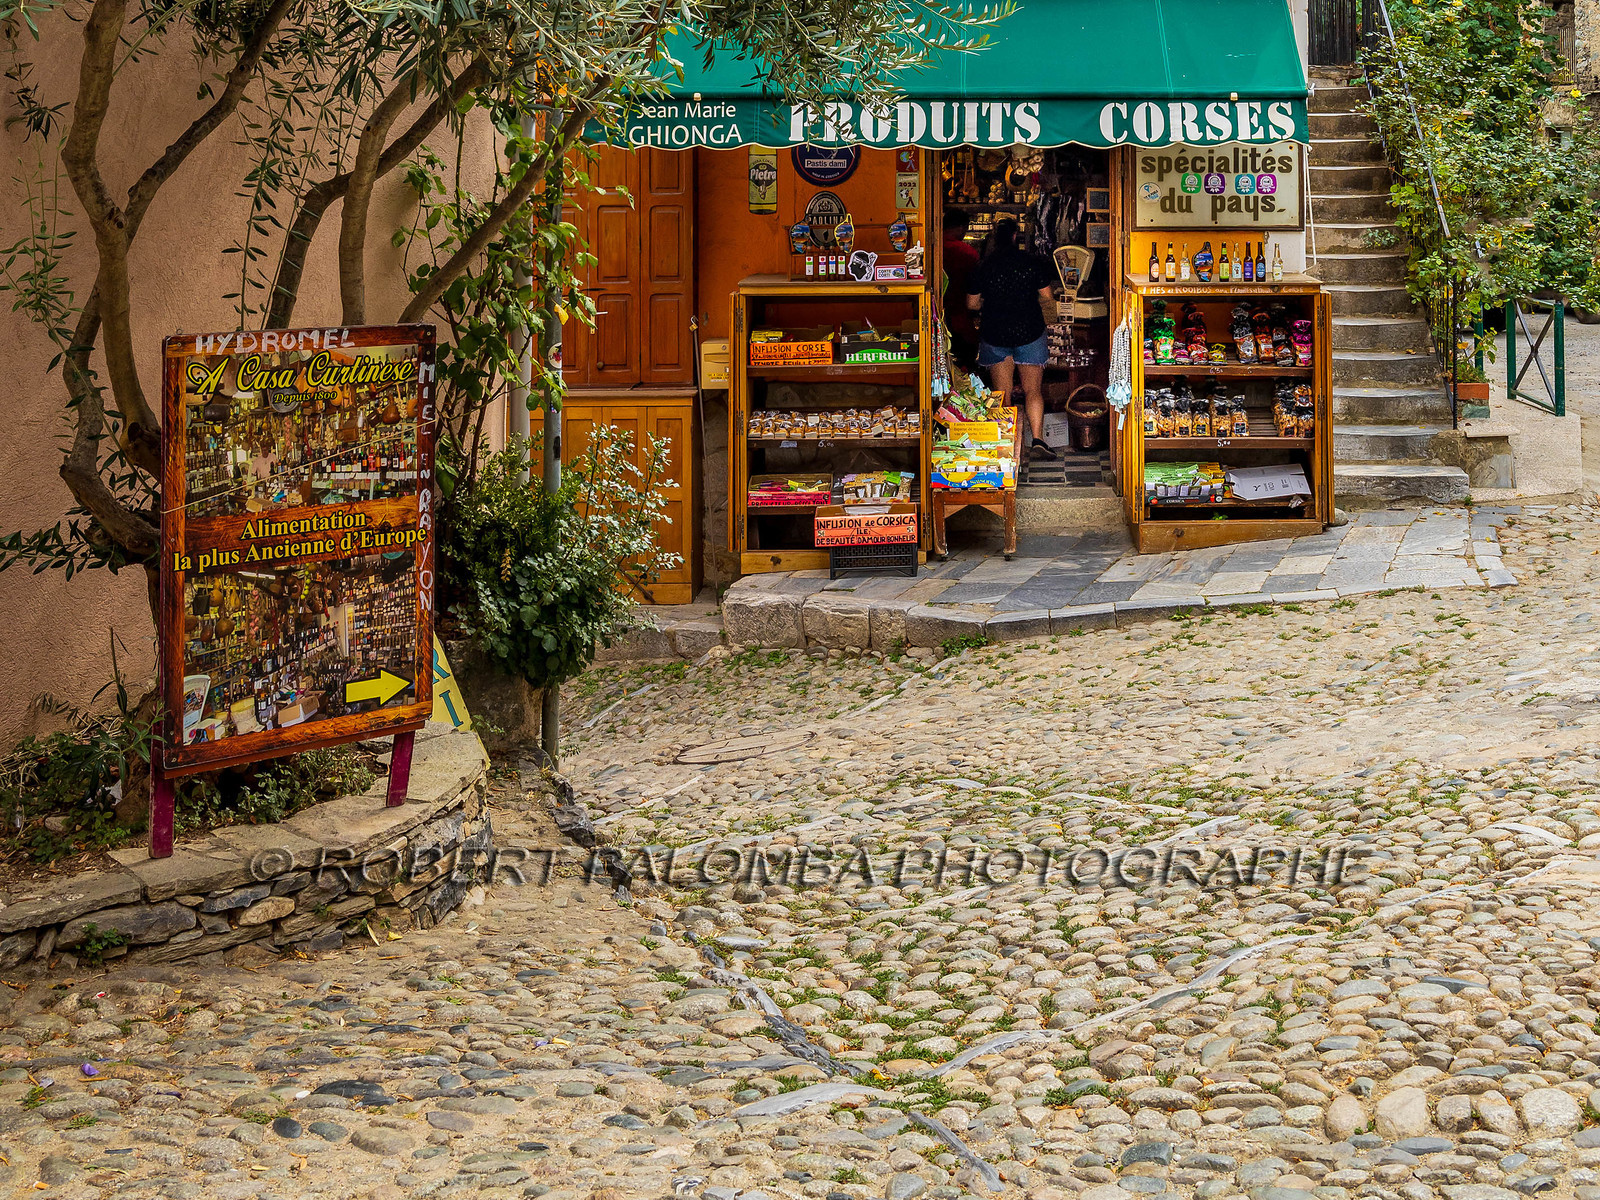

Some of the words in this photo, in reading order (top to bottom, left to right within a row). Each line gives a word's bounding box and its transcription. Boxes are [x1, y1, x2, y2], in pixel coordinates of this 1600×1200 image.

[636, 102, 679, 119] Jean
[684, 102, 737, 118] Marie
[788, 101, 1042, 143] PRODUITS
[1099, 101, 1296, 144] CORSES
[628, 123, 743, 146] GHIONGA
[750, 168, 777, 181] Pietra
[806, 160, 827, 168] Pastis
[829, 160, 846, 168] dami
[1140, 147, 1293, 182] spécialités
[1159, 187, 1194, 214] du
[194, 328, 356, 356] HYDROMEL
[752, 343, 792, 354] INFUSION
[796, 343, 826, 352] CORSE
[845, 351, 909, 363] HERFRUIT
[235, 354, 298, 392] Casa
[306, 350, 416, 388] Curtinese
[273, 390, 312, 405] Depuis
[313, 390, 338, 402] 1800
[417, 361, 437, 435] MIEL
[419, 452, 432, 480] EN
[240, 510, 367, 540] Alimentation
[816, 517, 862, 530] INFUSION
[876, 515, 916, 527] CORSICA
[173, 552, 193, 572] la
[198, 546, 241, 572] plus
[244, 537, 336, 563] Ancienne
[339, 526, 428, 552] d'Europe
